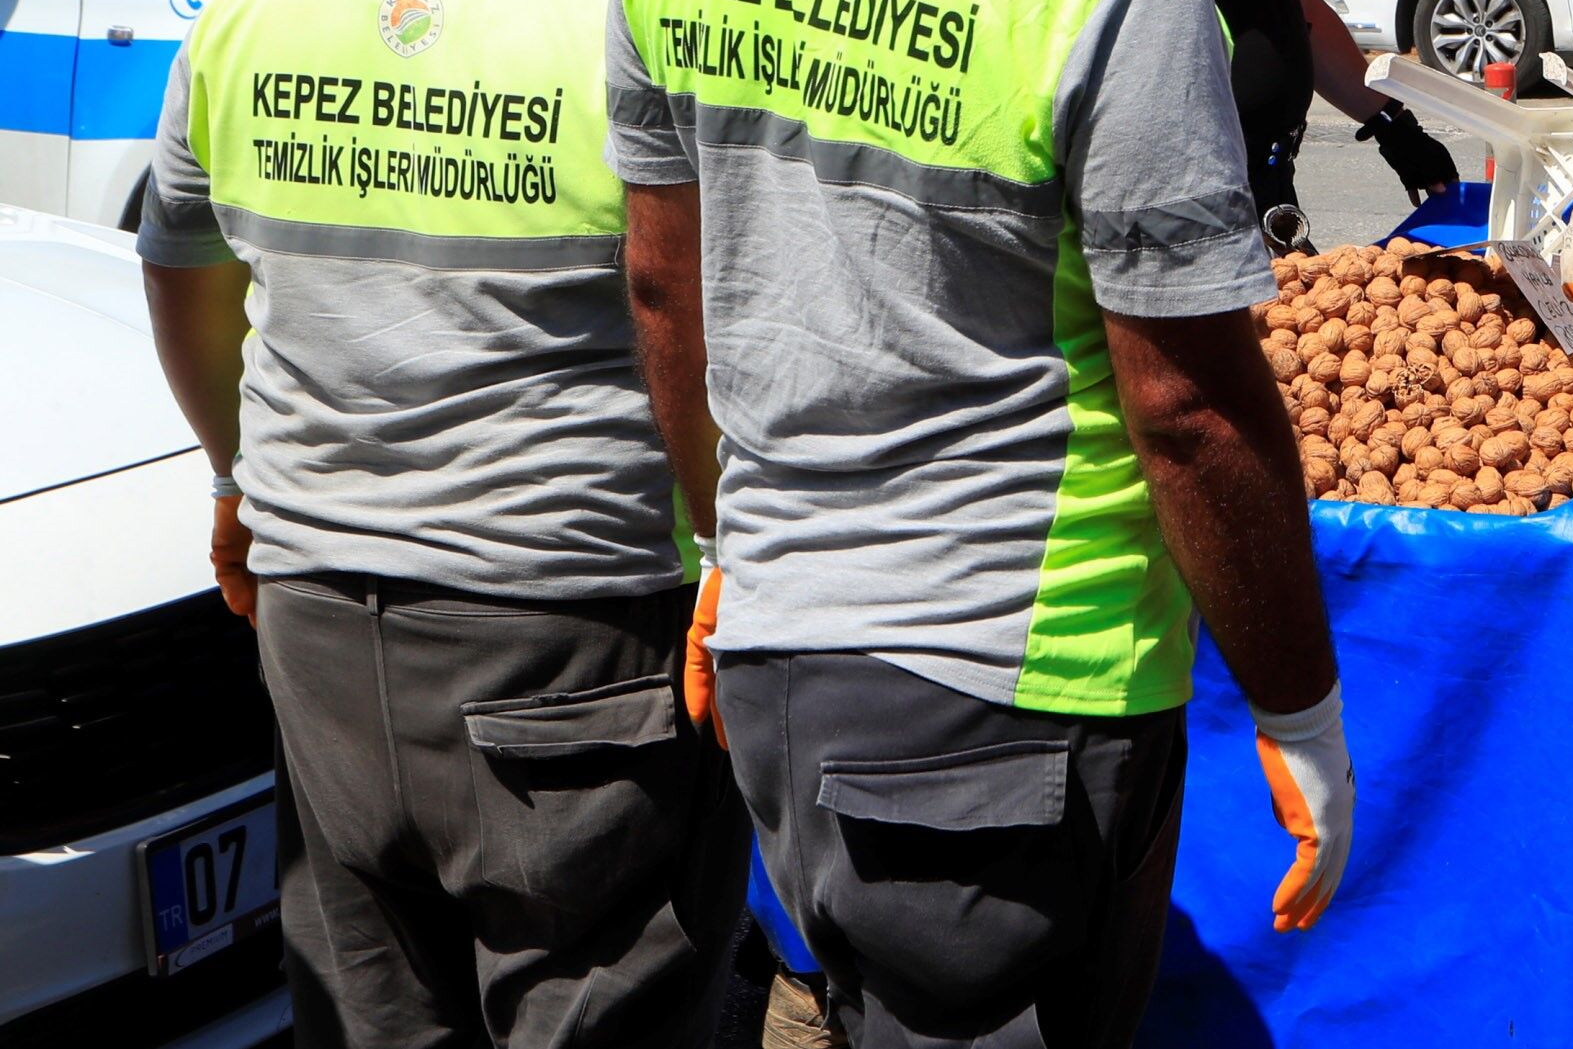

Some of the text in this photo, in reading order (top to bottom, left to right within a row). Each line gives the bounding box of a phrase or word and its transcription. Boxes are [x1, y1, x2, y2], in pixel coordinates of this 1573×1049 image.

[252, 72, 564, 144] KEPEZ BELEDİYESİ
[659, 9, 746, 80] TEMİLİK
[802, 51, 962, 147] MÜDÜRLÜĞÜ
[252, 132, 344, 187] TEMİZLİK
[416, 145, 557, 205] MÜDÜRLÜĞÜ
[159, 824, 247, 932] TR 07
